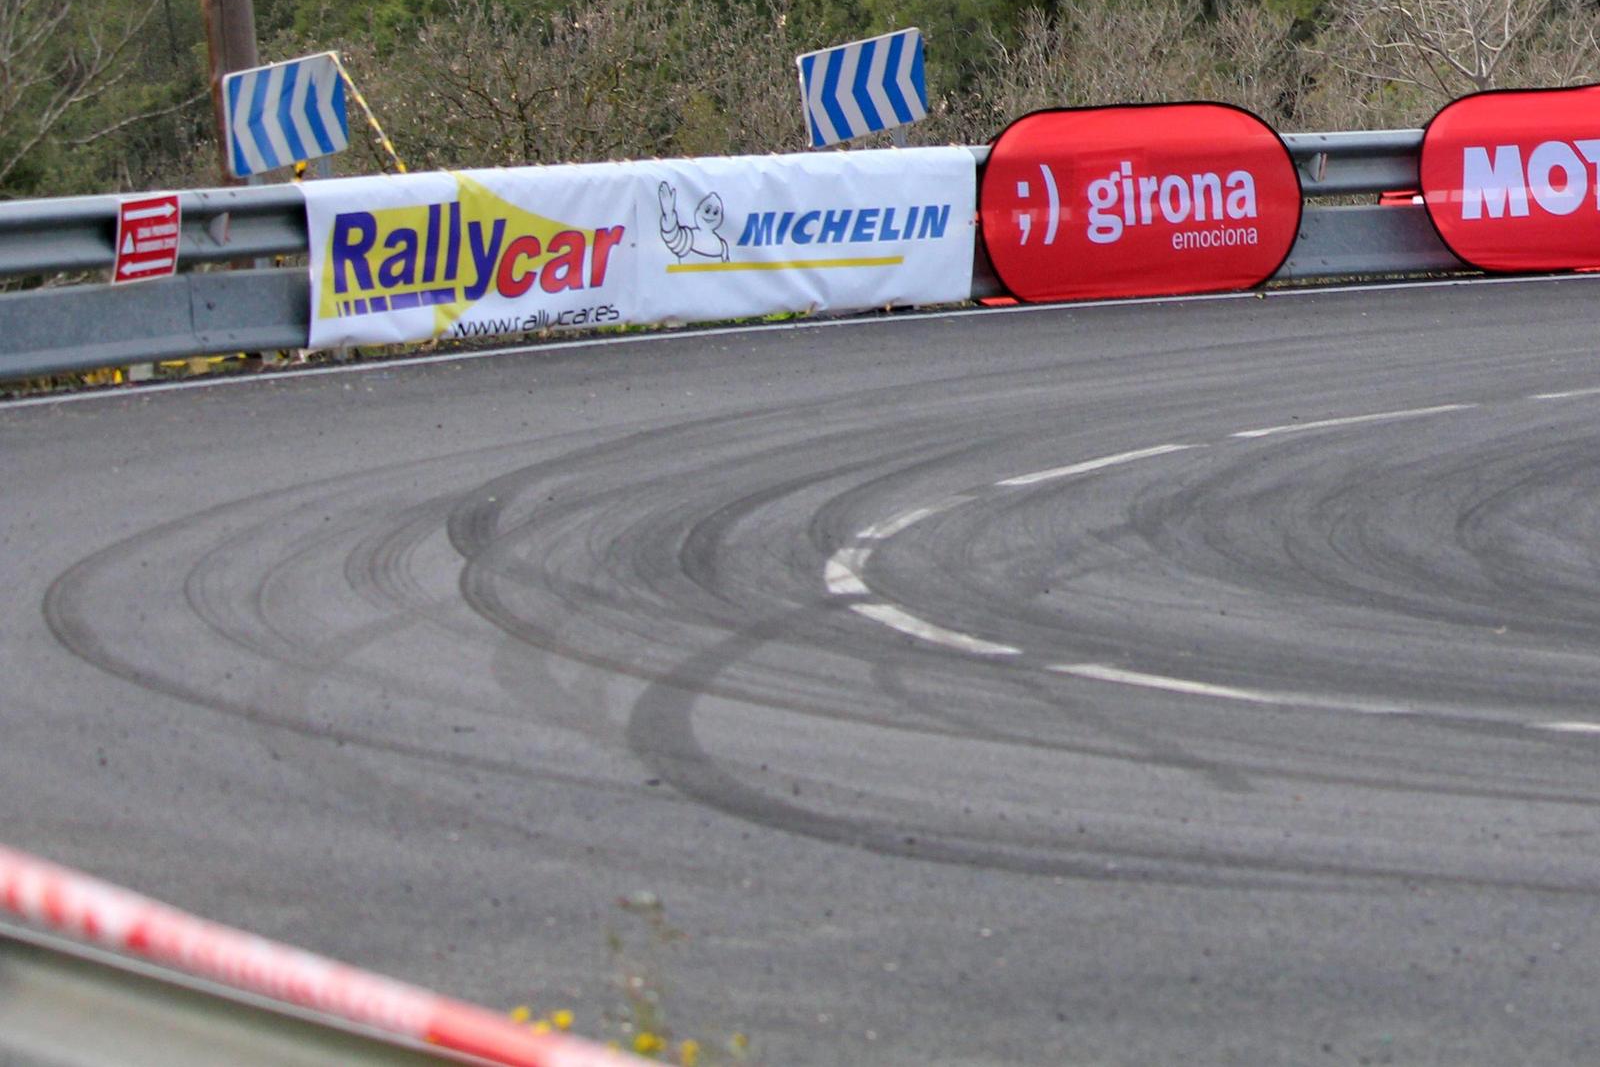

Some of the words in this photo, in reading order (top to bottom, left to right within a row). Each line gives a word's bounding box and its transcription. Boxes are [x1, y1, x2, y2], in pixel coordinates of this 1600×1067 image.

[1086, 161, 1258, 244] girona
[736, 204, 951, 247] MICHELIN
[1171, 226, 1259, 250] emociona
